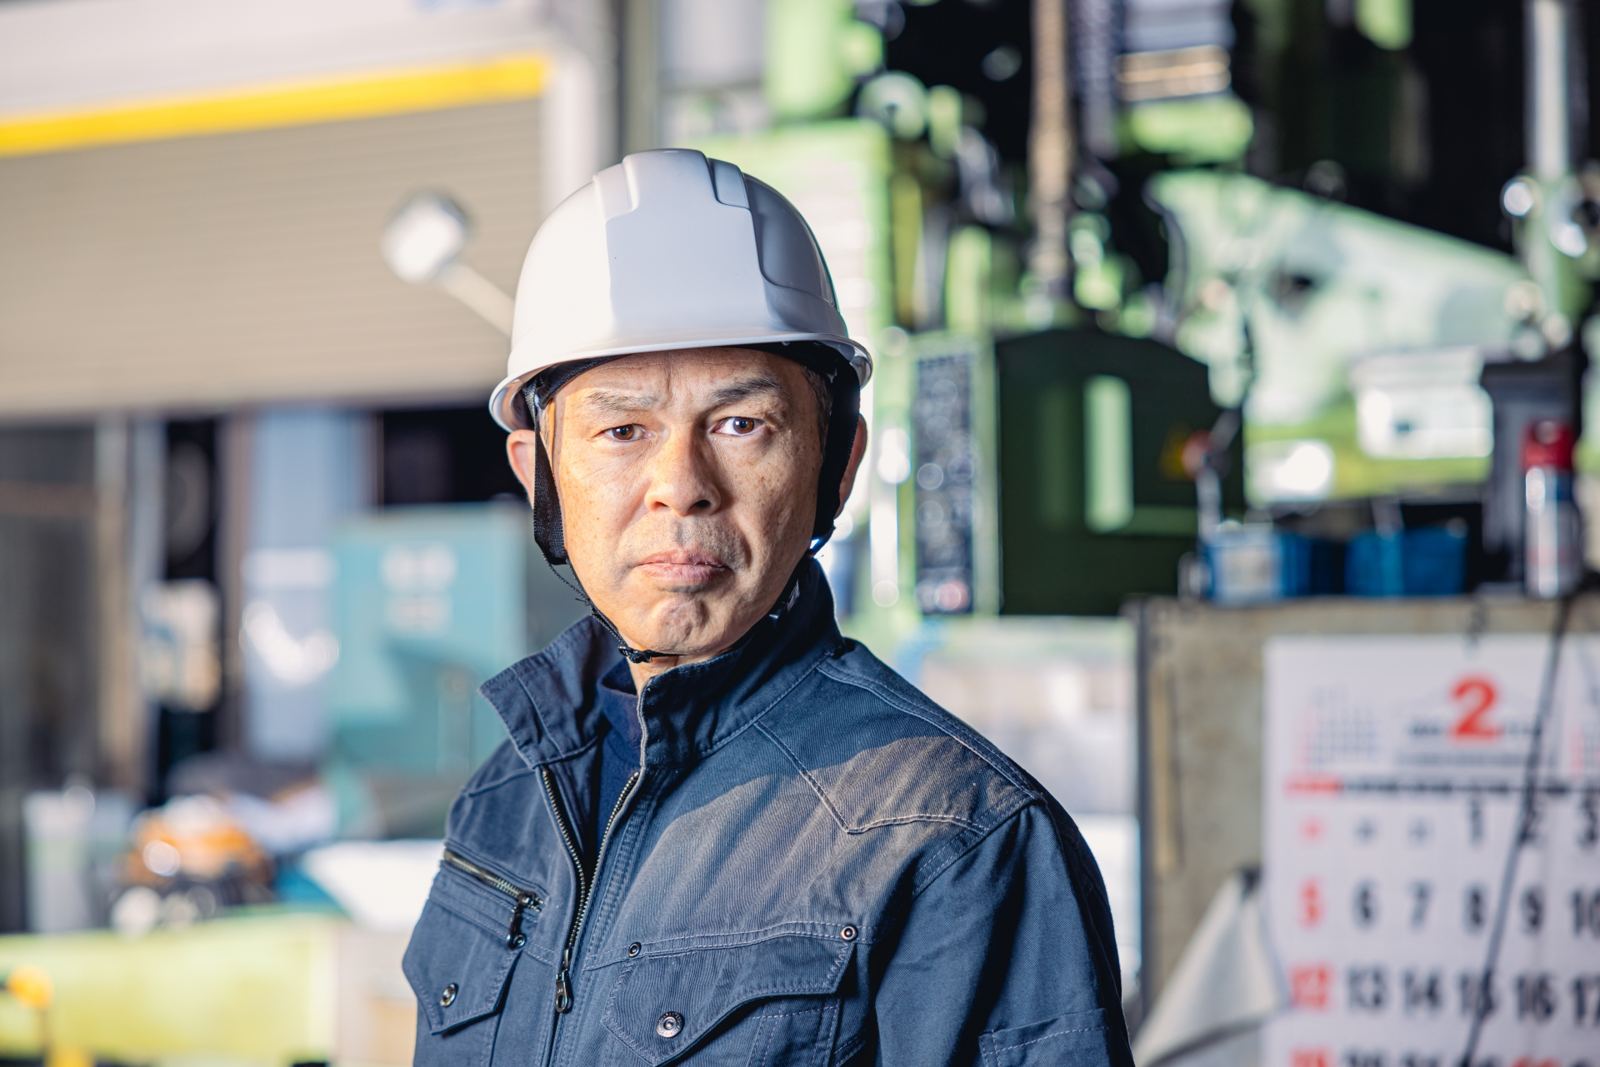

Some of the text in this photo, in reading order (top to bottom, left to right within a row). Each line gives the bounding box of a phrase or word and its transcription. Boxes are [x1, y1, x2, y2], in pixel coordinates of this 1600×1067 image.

[1451, 676, 1501, 740] 2
[1299, 879, 1324, 928] 5
[1352, 880, 1378, 930] 6
[1408, 880, 1433, 930] 7
[1463, 885, 1487, 934] 8
[1521, 886, 1545, 935] 9
[1290, 965, 1331, 1011] 12
[1347, 967, 1386, 1012] 13
[1403, 971, 1442, 1014] 14
[1516, 975, 1556, 1023] 16
